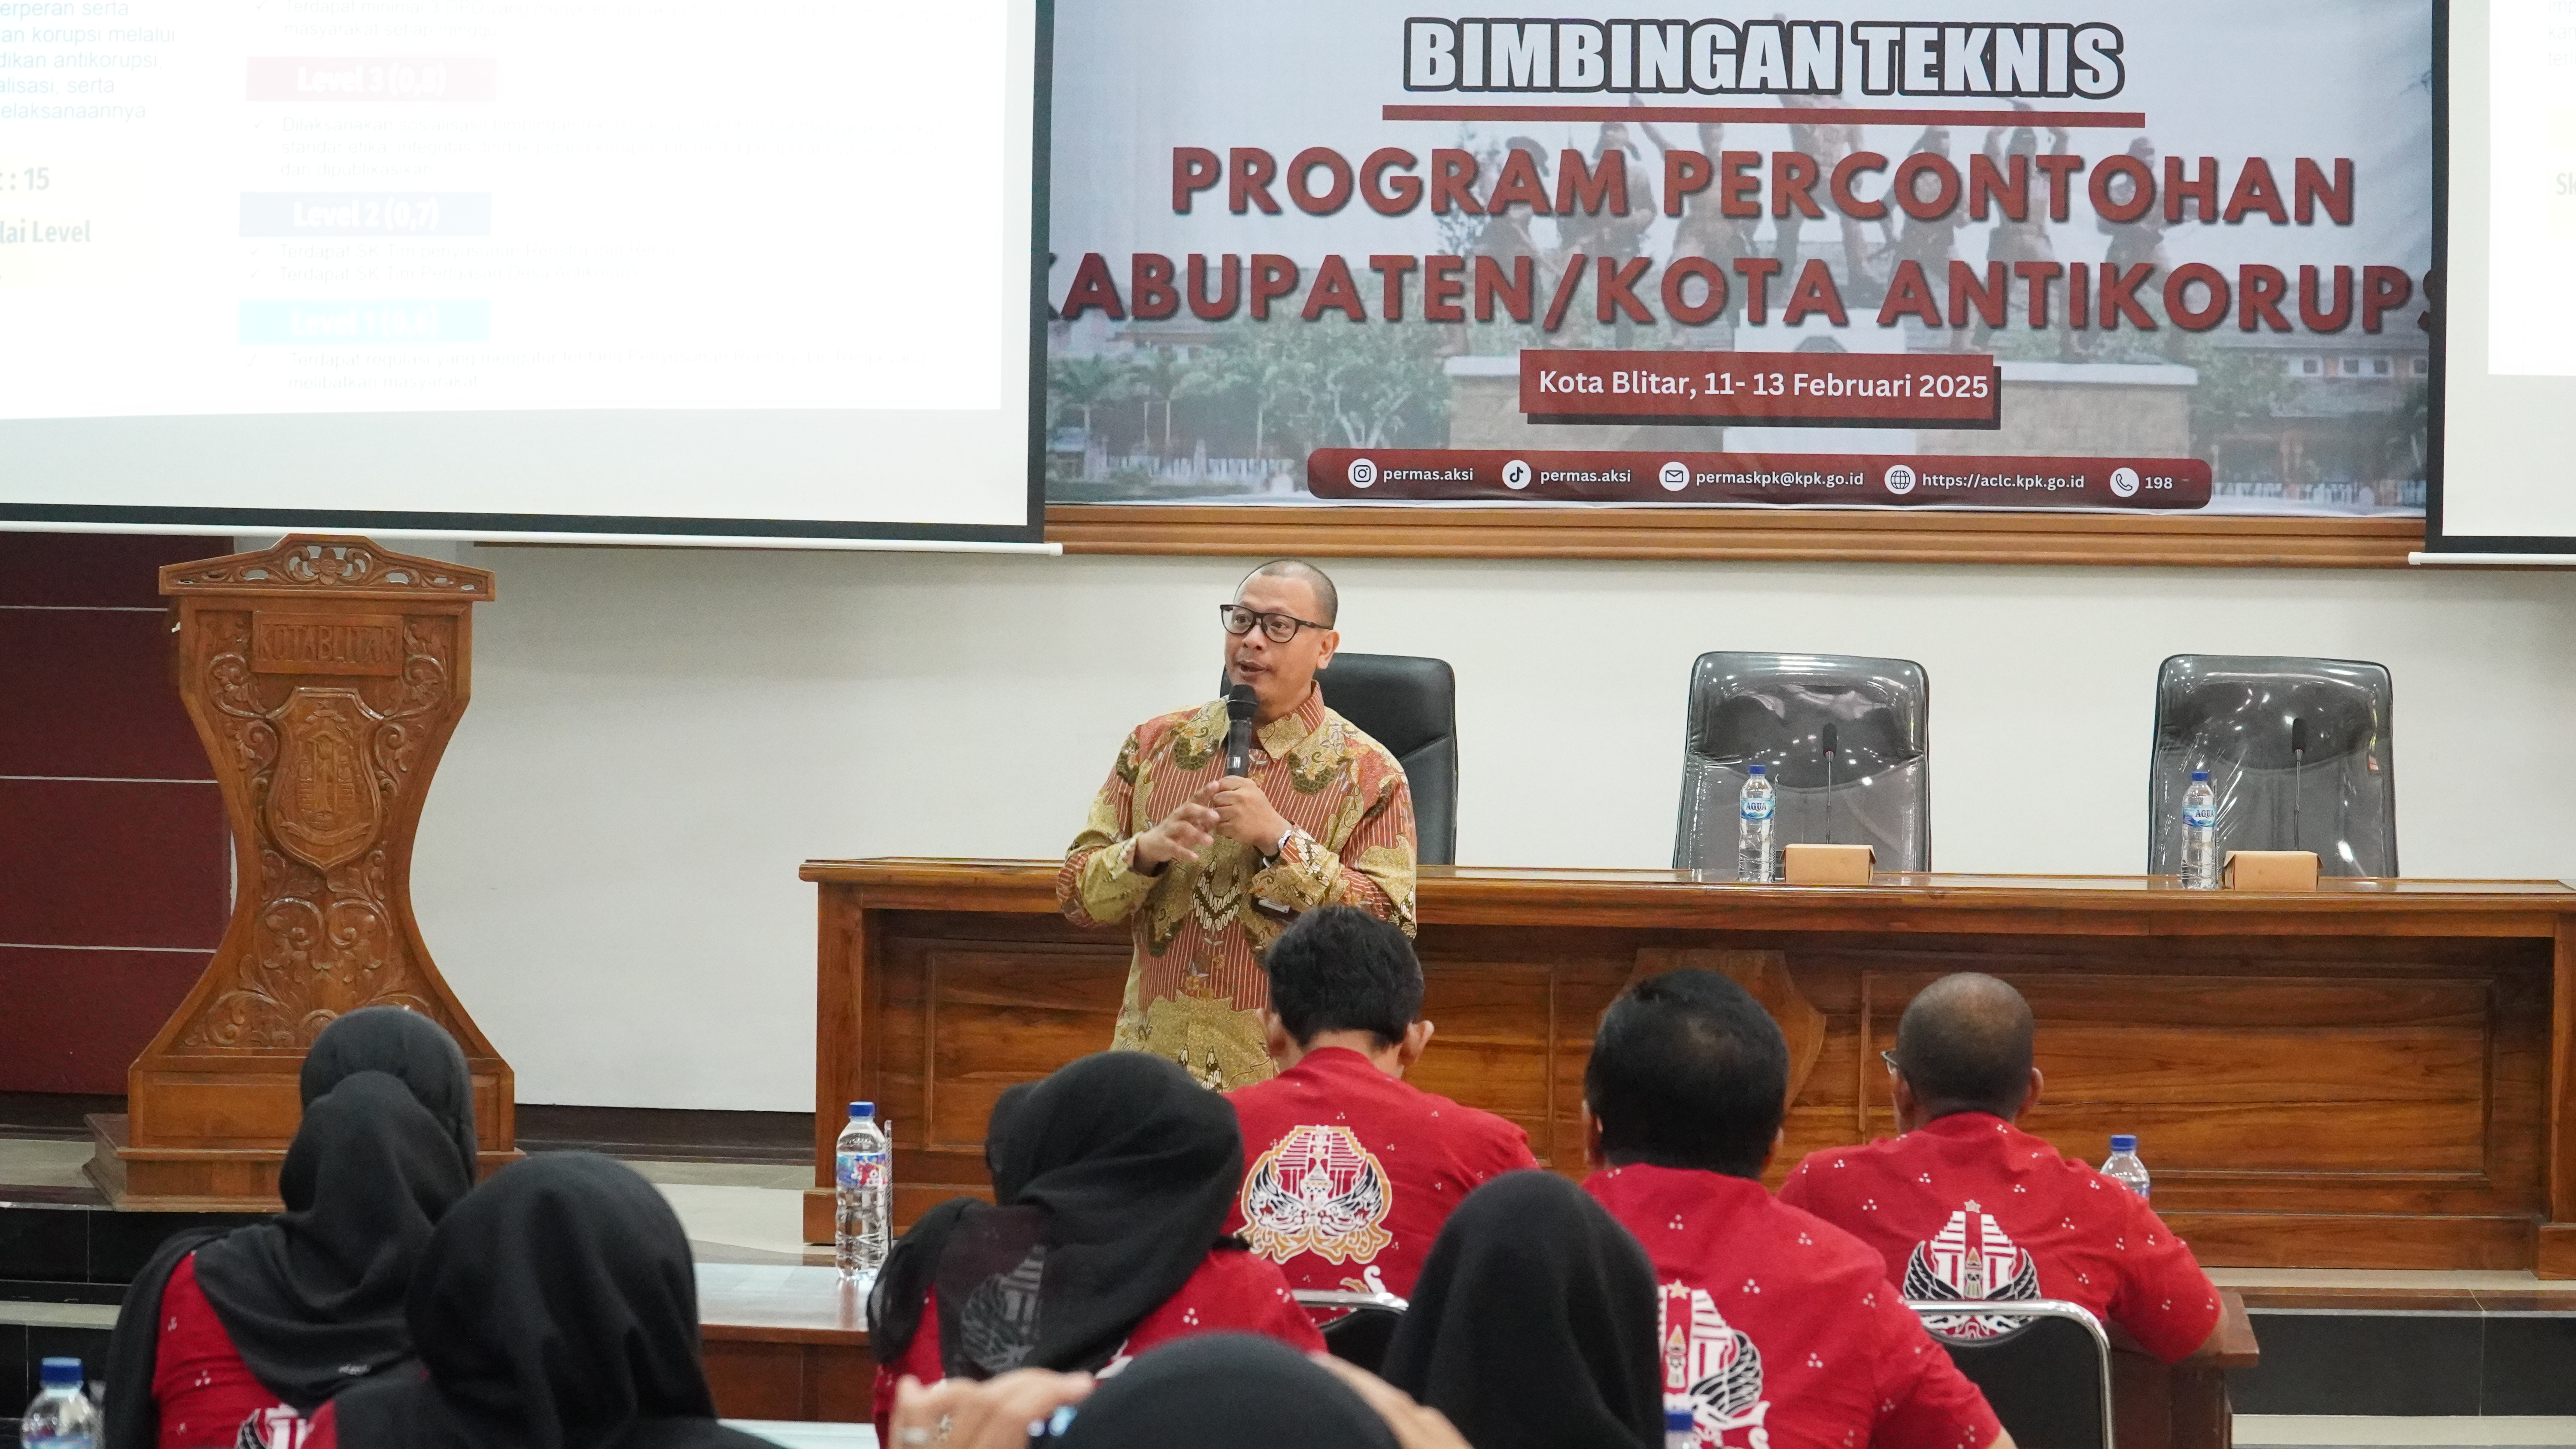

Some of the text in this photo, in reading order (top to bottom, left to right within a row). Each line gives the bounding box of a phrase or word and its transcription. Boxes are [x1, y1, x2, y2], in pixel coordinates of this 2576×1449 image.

[0, 0, 129, 21] erperan serta
[32, 26, 101, 47] korupsi
[109, 26, 176, 42] melalui
[283, 22, 379, 39] masyarakat
[53, 51, 163, 72] antikorupsi,
[1403, 17, 2126, 99] BIMBINGAN TEKNIS
[67, 77, 115, 94] serta
[297, 61, 447, 97] Level 3 (0,8)
[1, 102, 146, 123] elaksanaannya
[283, 116, 392, 132] Dilaksanakan
[282, 141, 343, 154] standar
[280, 162, 311, 176] dan
[23, 166, 50, 191] 15
[1172, 146, 2356, 226] PROGRAM PERCONTOHAN
[293, 197, 440, 232] Level 2 (0,7)
[0, 217, 92, 244] lai Level
[280, 243, 350, 261] Terdapat
[356, 243, 380, 258] SK
[279, 266, 349, 283] Terdapat
[356, 266, 380, 280] SK
[290, 308, 358, 336] Level
[364, 310, 376, 334] 1
[290, 352, 361, 370] Terdapat
[1539, 370, 1604, 394] Kota
[1613, 370, 1697, 400] Blitar,
[1753, 373, 1784, 396] 13
[1794, 373, 1912, 398] Februari
[1920, 374, 1989, 399] 2025
[1383, 467, 1473, 482] permas.aksi
[1540, 469, 1631, 484] permas.aksi
[1696, 471, 1864, 488] permaskpk@kpk.go.id
[1922, 473, 2084, 490] https://aclc.kpk.go.id
[2145, 476, 2173, 490] 198
[1746, 802, 1767, 812] AQUA
[2195, 809, 2214, 819] AQUA
